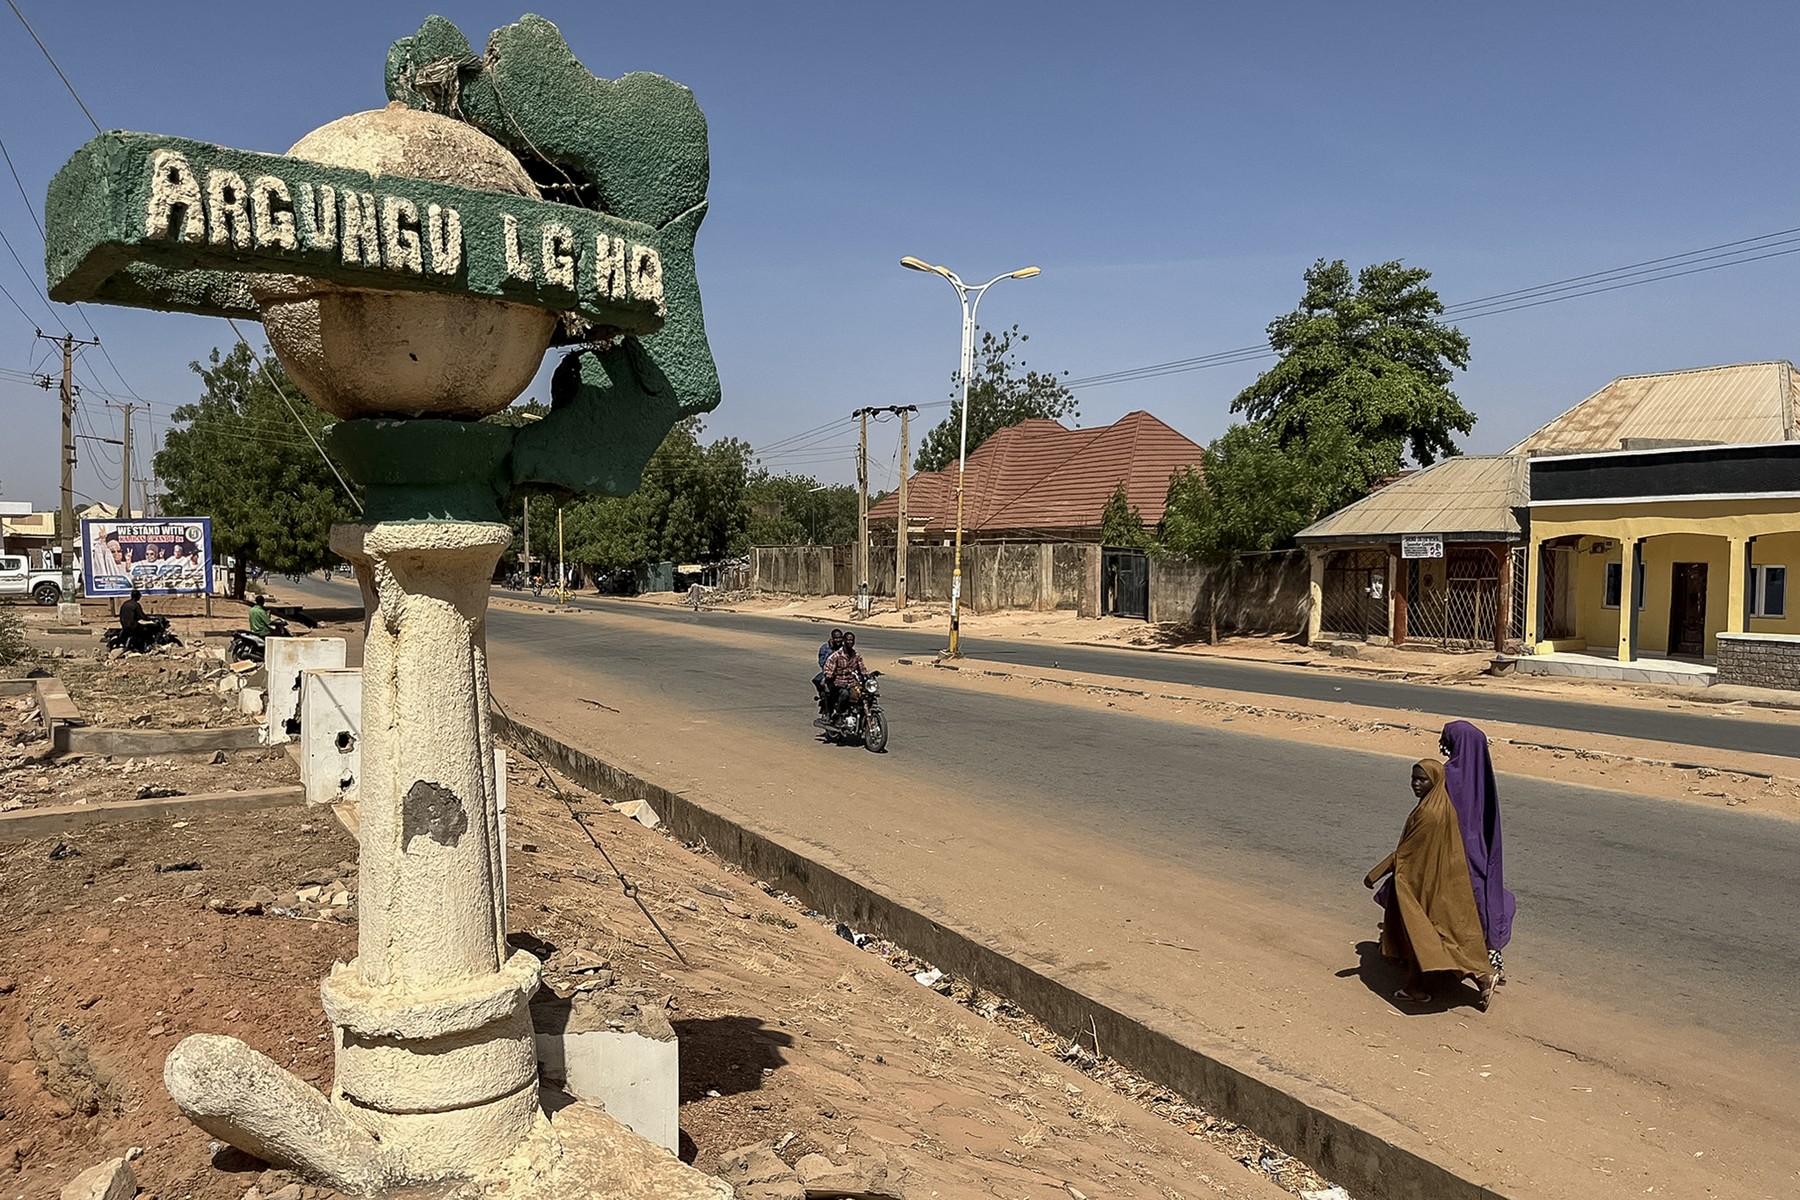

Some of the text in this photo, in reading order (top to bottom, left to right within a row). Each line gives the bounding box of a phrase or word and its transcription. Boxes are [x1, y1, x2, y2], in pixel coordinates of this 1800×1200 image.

[145, 149, 463, 276] ARGUNGU
[595, 233, 668, 316] HQ
[118, 526, 184, 535] WE STAND WITH
